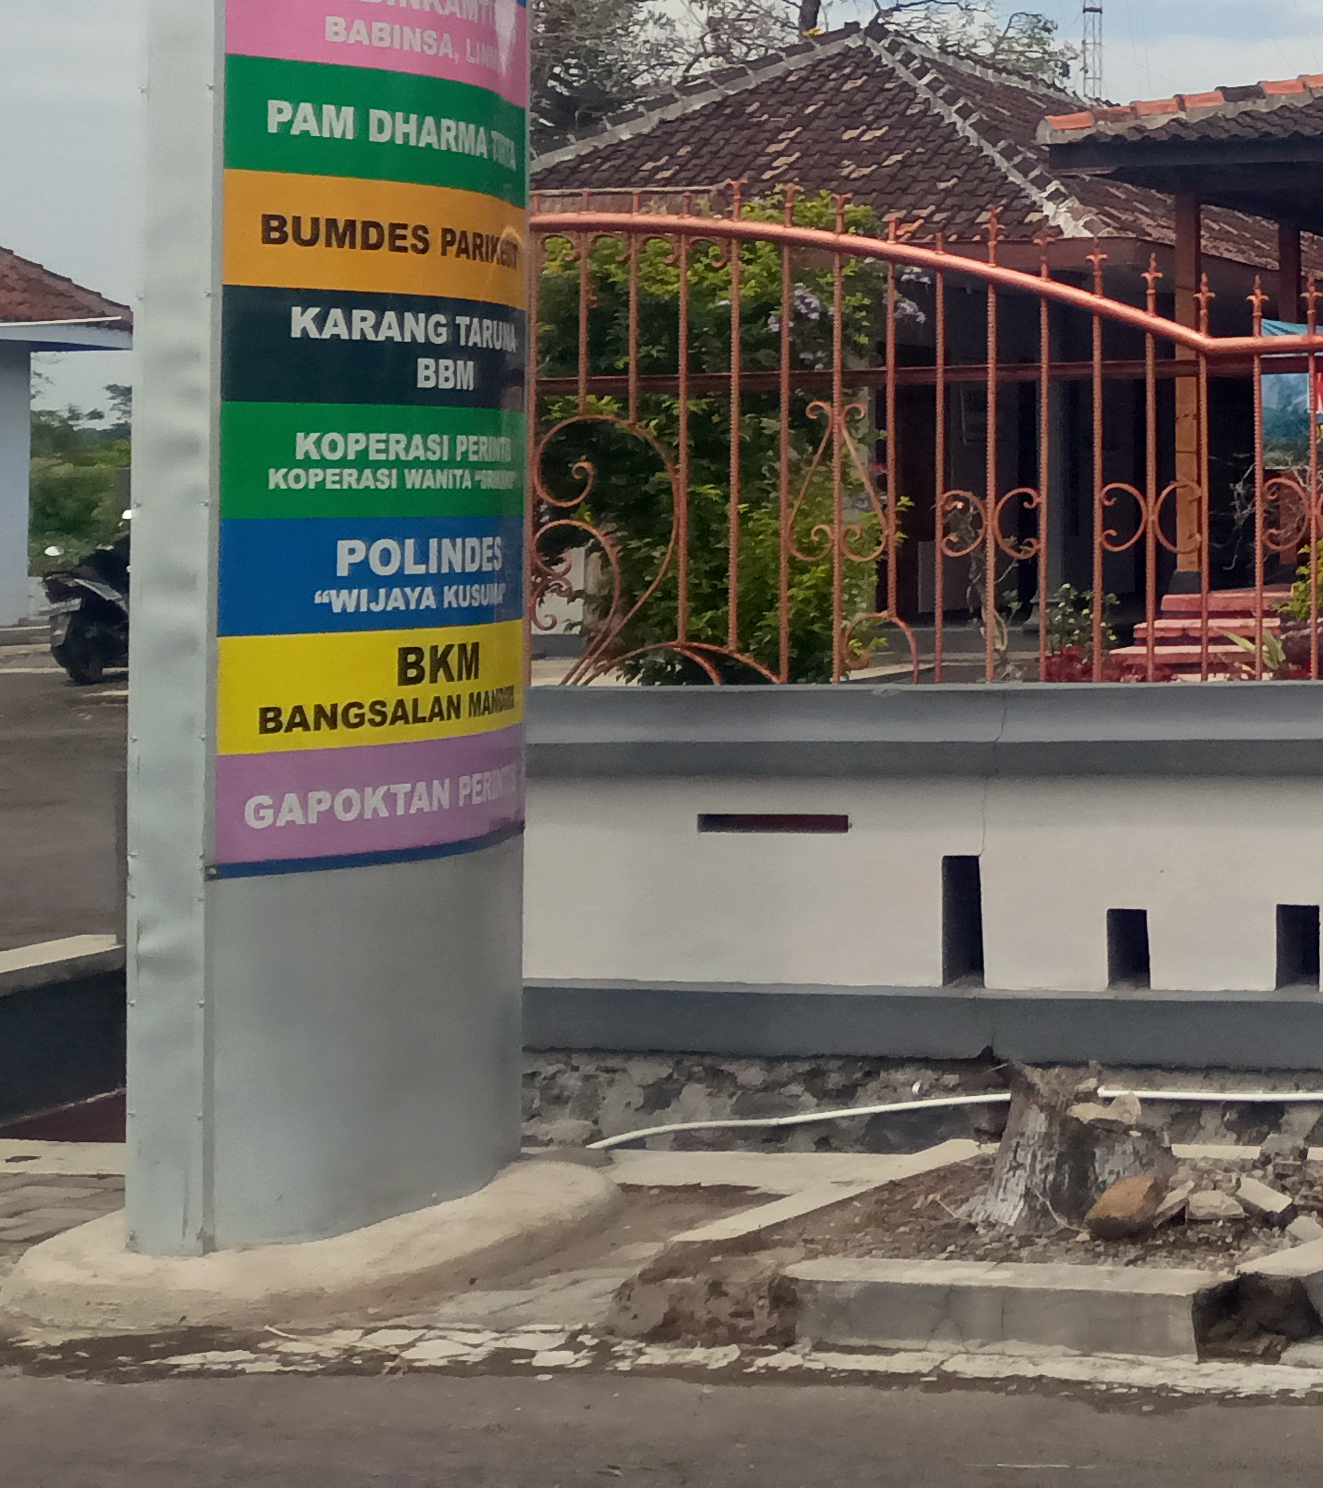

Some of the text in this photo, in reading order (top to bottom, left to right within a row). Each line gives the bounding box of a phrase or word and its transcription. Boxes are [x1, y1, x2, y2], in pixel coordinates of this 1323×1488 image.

[325, 16, 460, 64] BABINSA,
[267, 99, 355, 140] PAM
[369, 109, 488, 159] DHARMA
[261, 213, 430, 255] BUMDES
[290, 307, 517, 353] KARANG TARUNA
[417, 358, 474, 391] BBM
[296, 432, 449, 462] KOPERASI
[268, 468, 397, 490] KOPERASI
[404, 469, 472, 490] WANITA
[336, 537, 503, 577] POLINDES
[397, 641, 480, 686] BKM
[258, 693, 462, 735] BANGSALAN
[244, 778, 450, 829] GAPOKTAN
